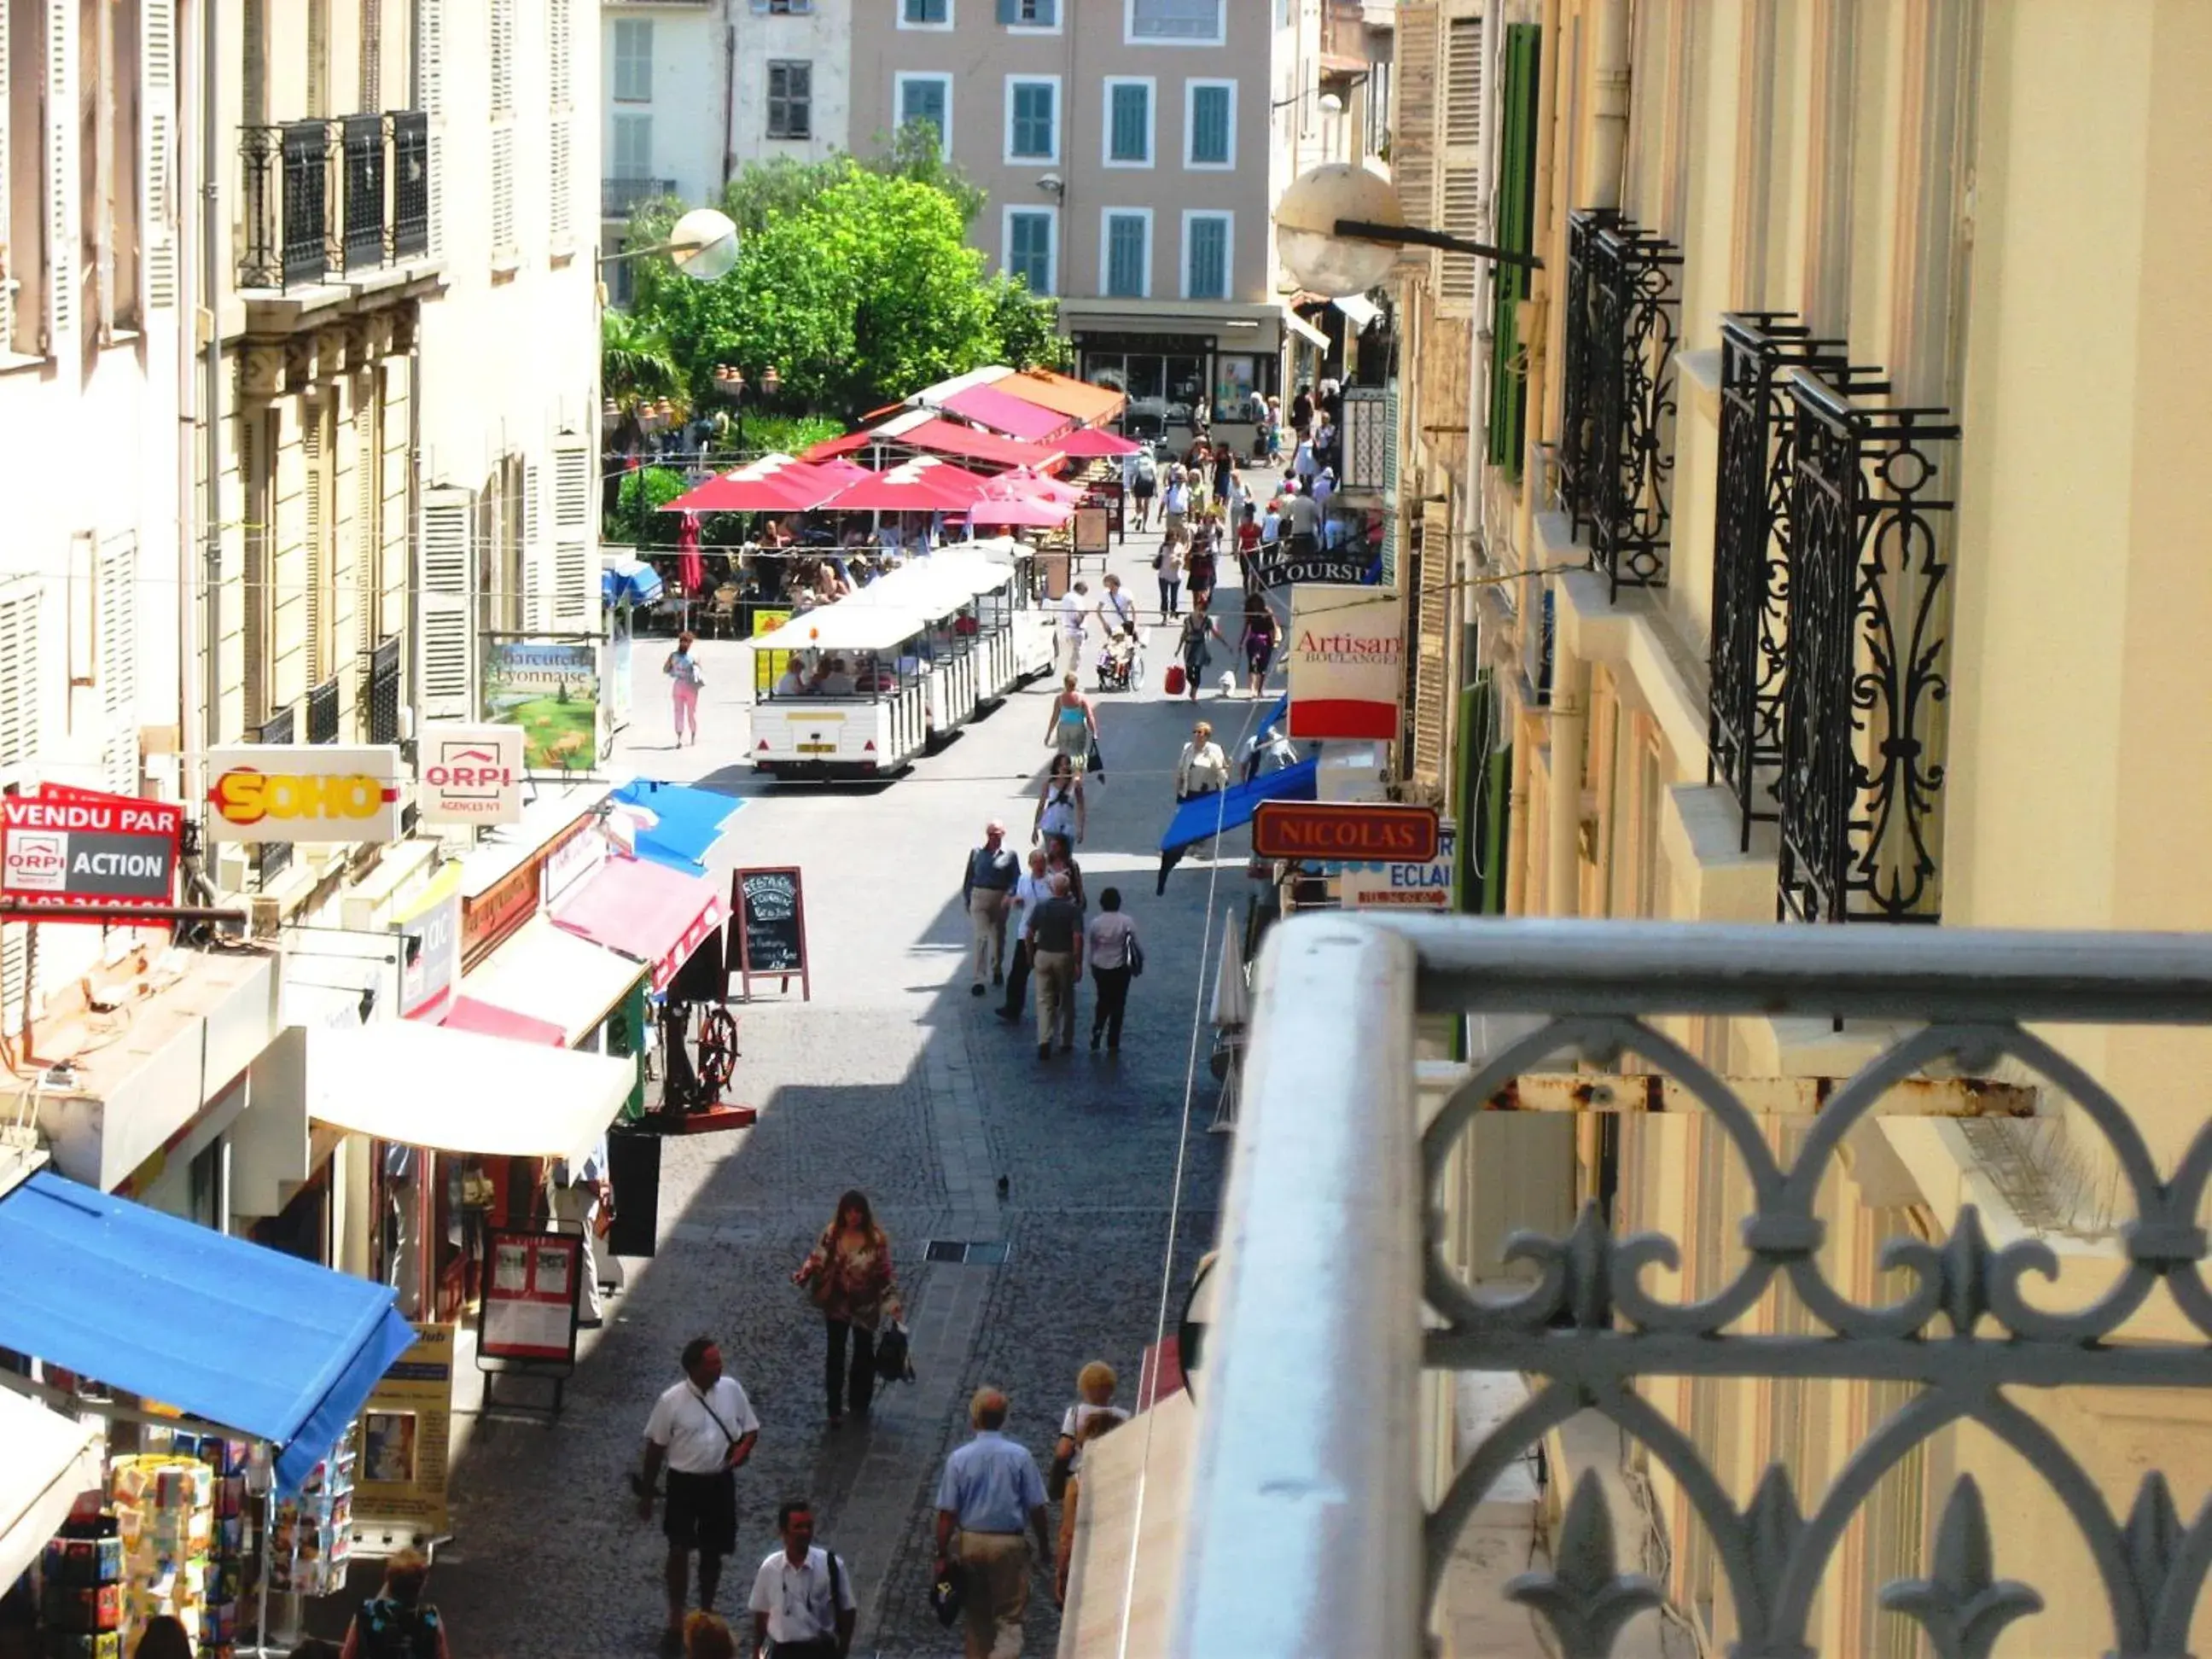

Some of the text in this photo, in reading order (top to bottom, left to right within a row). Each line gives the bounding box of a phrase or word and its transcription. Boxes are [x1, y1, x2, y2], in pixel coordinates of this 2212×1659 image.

[1295, 630, 1404, 655] Artisan
[497, 667, 587, 686] Lyonnaise
[427, 766, 509, 787] ORPI
[222, 772, 382, 821] SOHO
[5, 803, 175, 832] VENDU PAR
[1280, 820, 1416, 848] NICOLAS
[8, 851, 163, 877] ORPI ACTION
